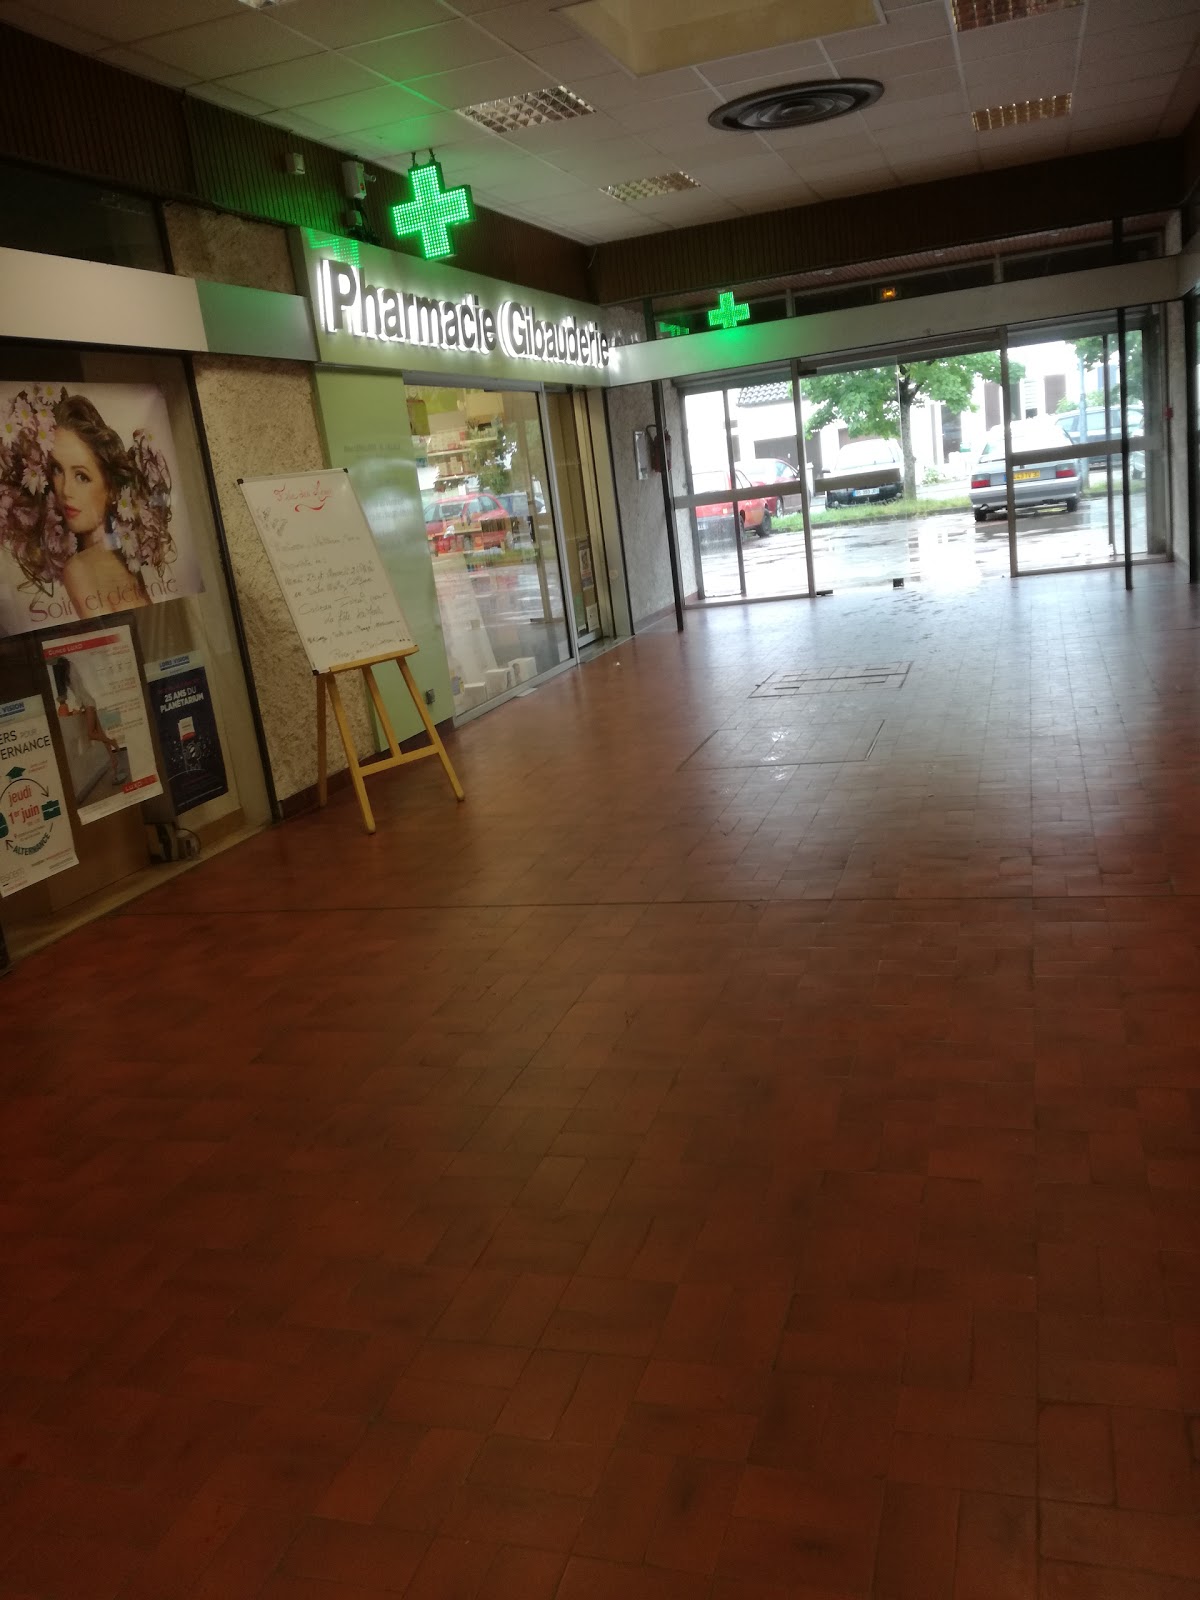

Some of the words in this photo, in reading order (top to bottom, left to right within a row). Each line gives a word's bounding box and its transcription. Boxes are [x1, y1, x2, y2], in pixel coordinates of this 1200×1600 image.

[321, 258, 497, 353] Pharmacie
[499, 301, 612, 368] Gibauderie
[29, 597, 78, 622] Soin
[164, 693, 173, 703] 25
[173, 689, 187, 700] ANS
[187, 686, 197, 695] DU
[8, 787, 33, 808] jeudi
[20, 804, 40, 824] juin
[13, 833, 51, 857] ALTERNANCE
